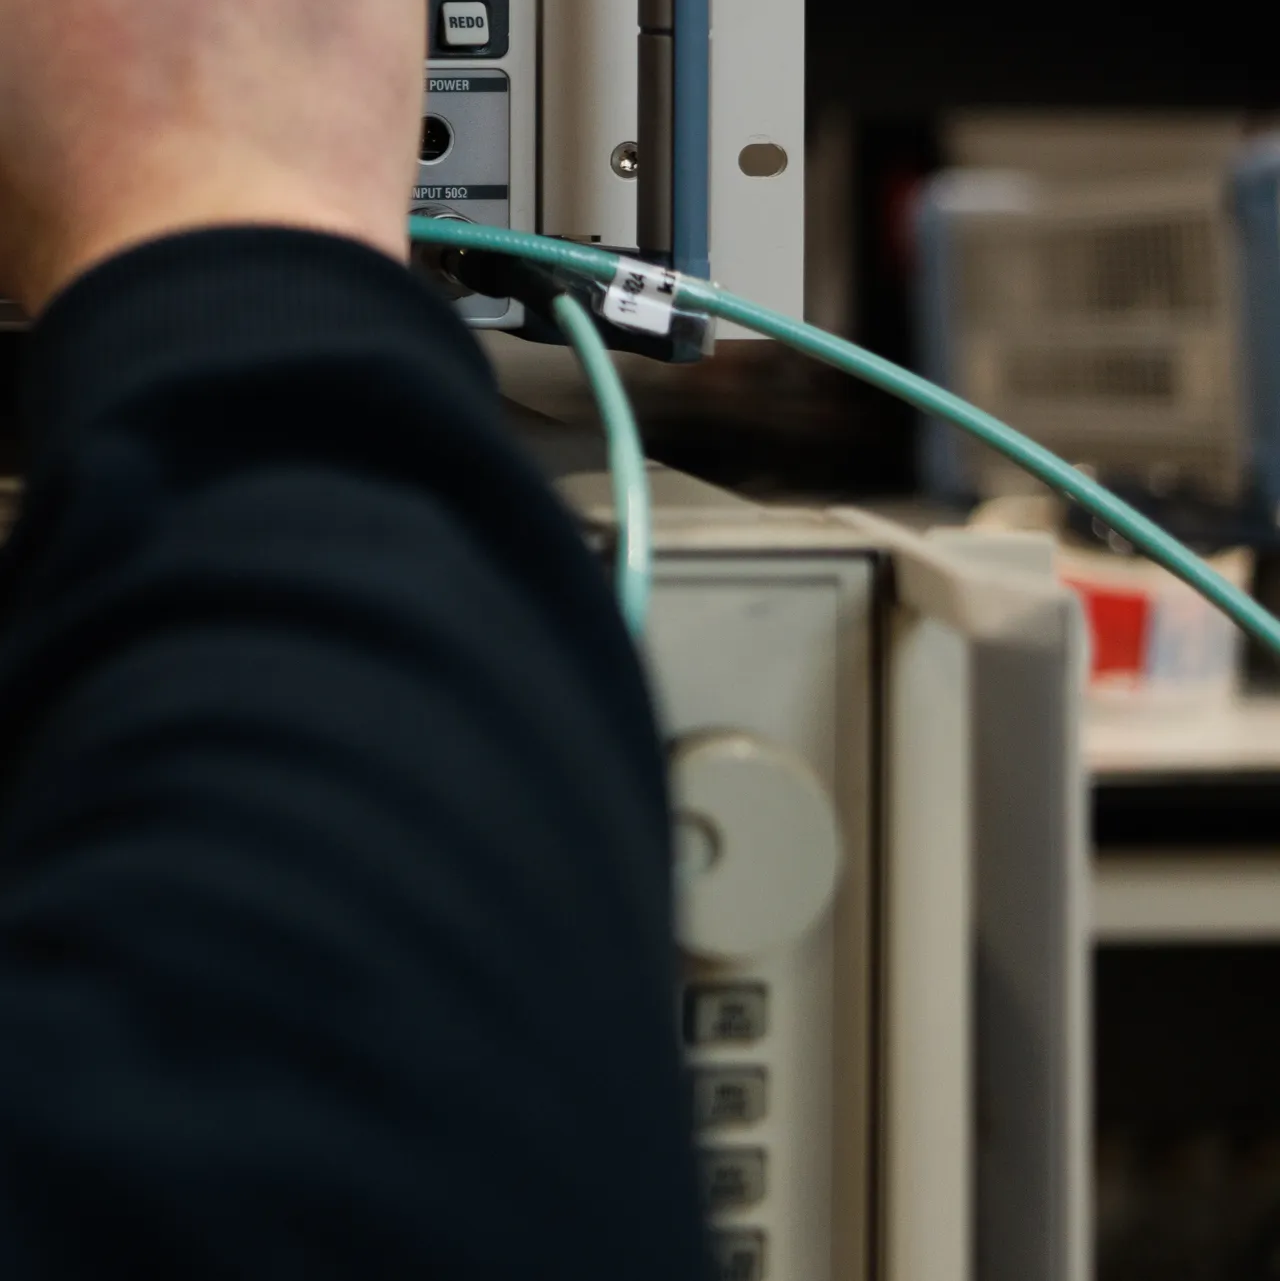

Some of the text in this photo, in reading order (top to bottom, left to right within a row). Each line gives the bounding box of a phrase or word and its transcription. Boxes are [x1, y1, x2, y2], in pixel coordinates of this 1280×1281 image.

[449, 16, 484, 28] REDO
[430, 80, 470, 91] POWER
[413, 187, 468, 199] NPUT 50Ω
